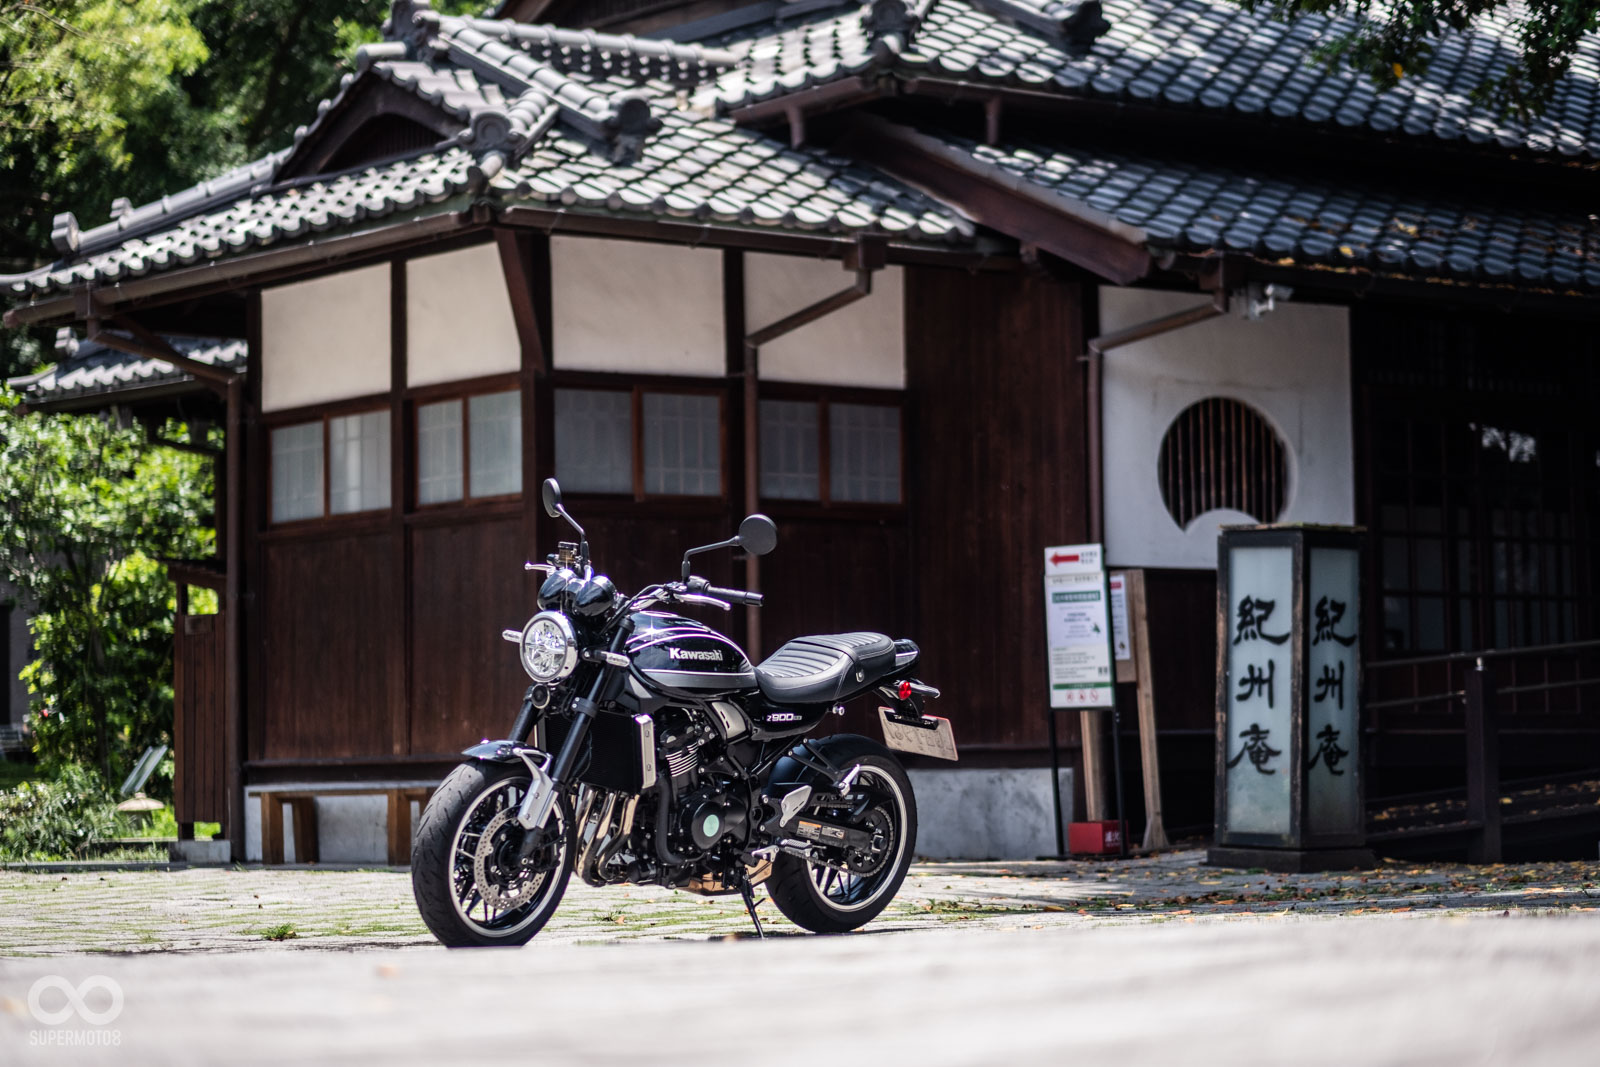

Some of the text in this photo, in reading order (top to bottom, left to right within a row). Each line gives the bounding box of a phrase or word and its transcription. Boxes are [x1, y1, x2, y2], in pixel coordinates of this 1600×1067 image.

[669, 648, 723, 661] Kawasaki
[1228, 595, 1291, 776] 紀州庵
[1307, 595, 1357, 776] 紀州庵
